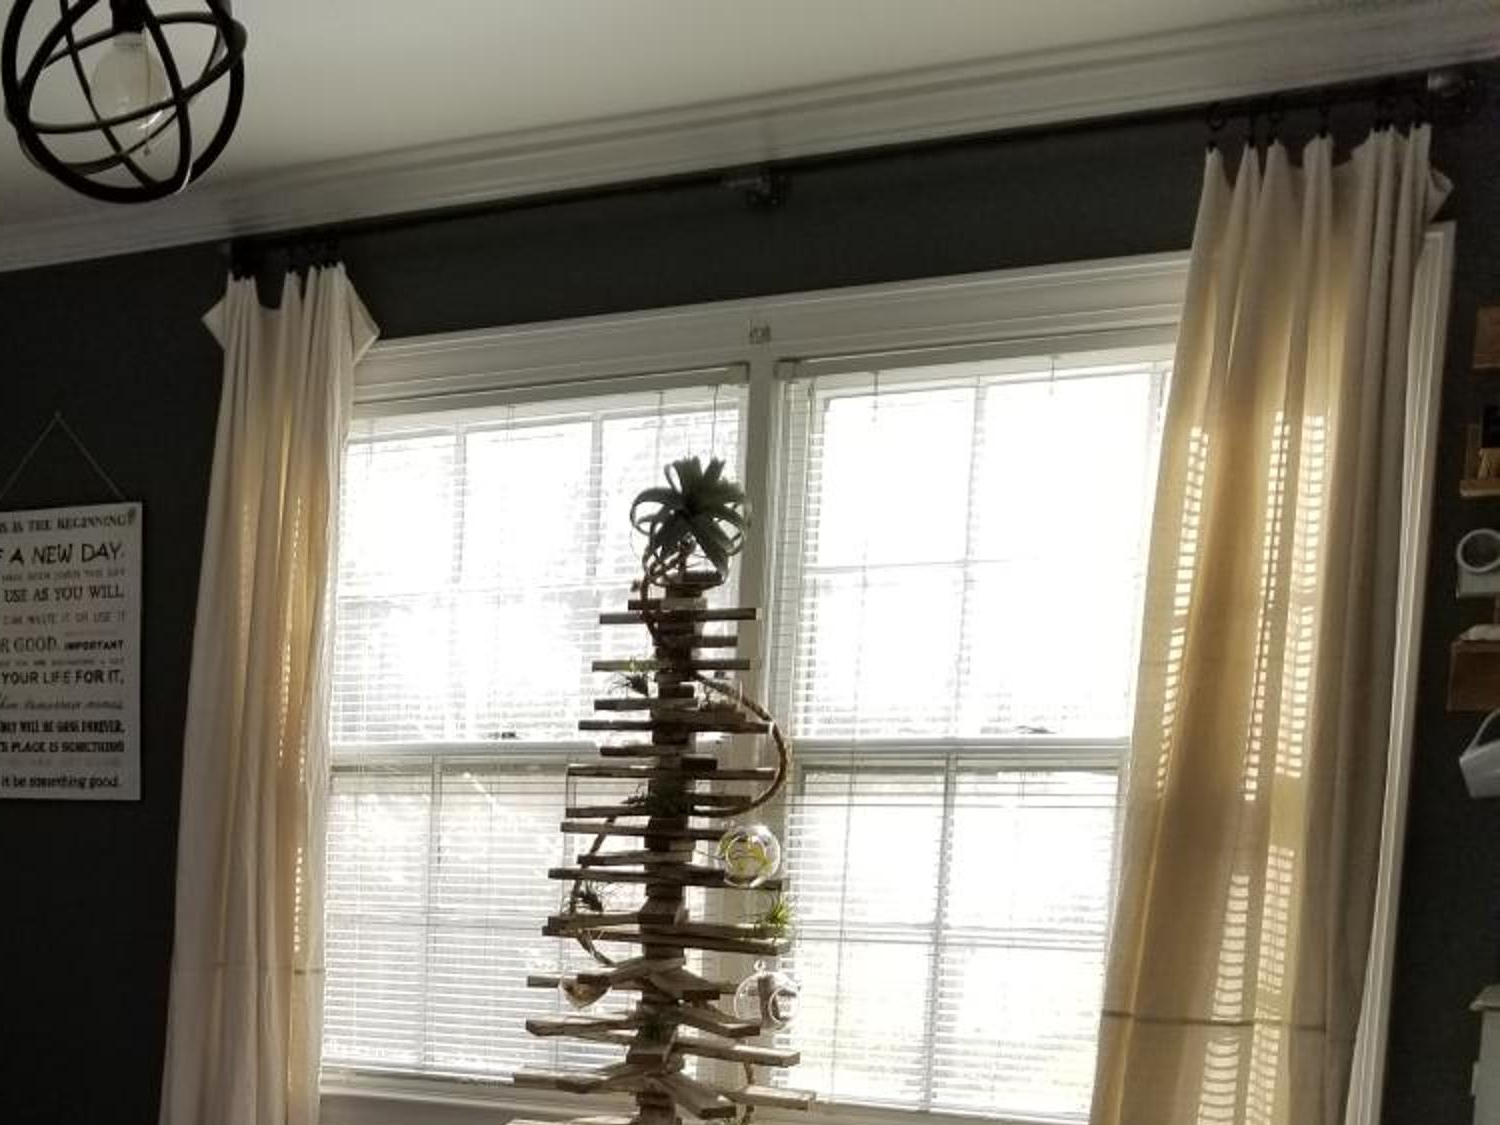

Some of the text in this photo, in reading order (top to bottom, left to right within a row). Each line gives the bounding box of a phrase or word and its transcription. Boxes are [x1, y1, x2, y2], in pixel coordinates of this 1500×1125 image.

[12, 520, 24, 534] IS
[28, 519, 52, 532] THE
[9, 548, 25, 566] A
[32, 544, 73, 564] NEW
[4, 588, 28, 603] USE
[33, 587, 49, 602] AS
[54, 586, 83, 601] YOU
[64, 639, 125, 651] IMPORTANT
[1, 671, 39, 685] YOUR
[43, 670, 70, 684] LIFE
[75, 669, 104, 684] FOR
[2, 775, 9, 788] it
[13, 774, 27, 788] be
[30, 774, 87, 790] something
